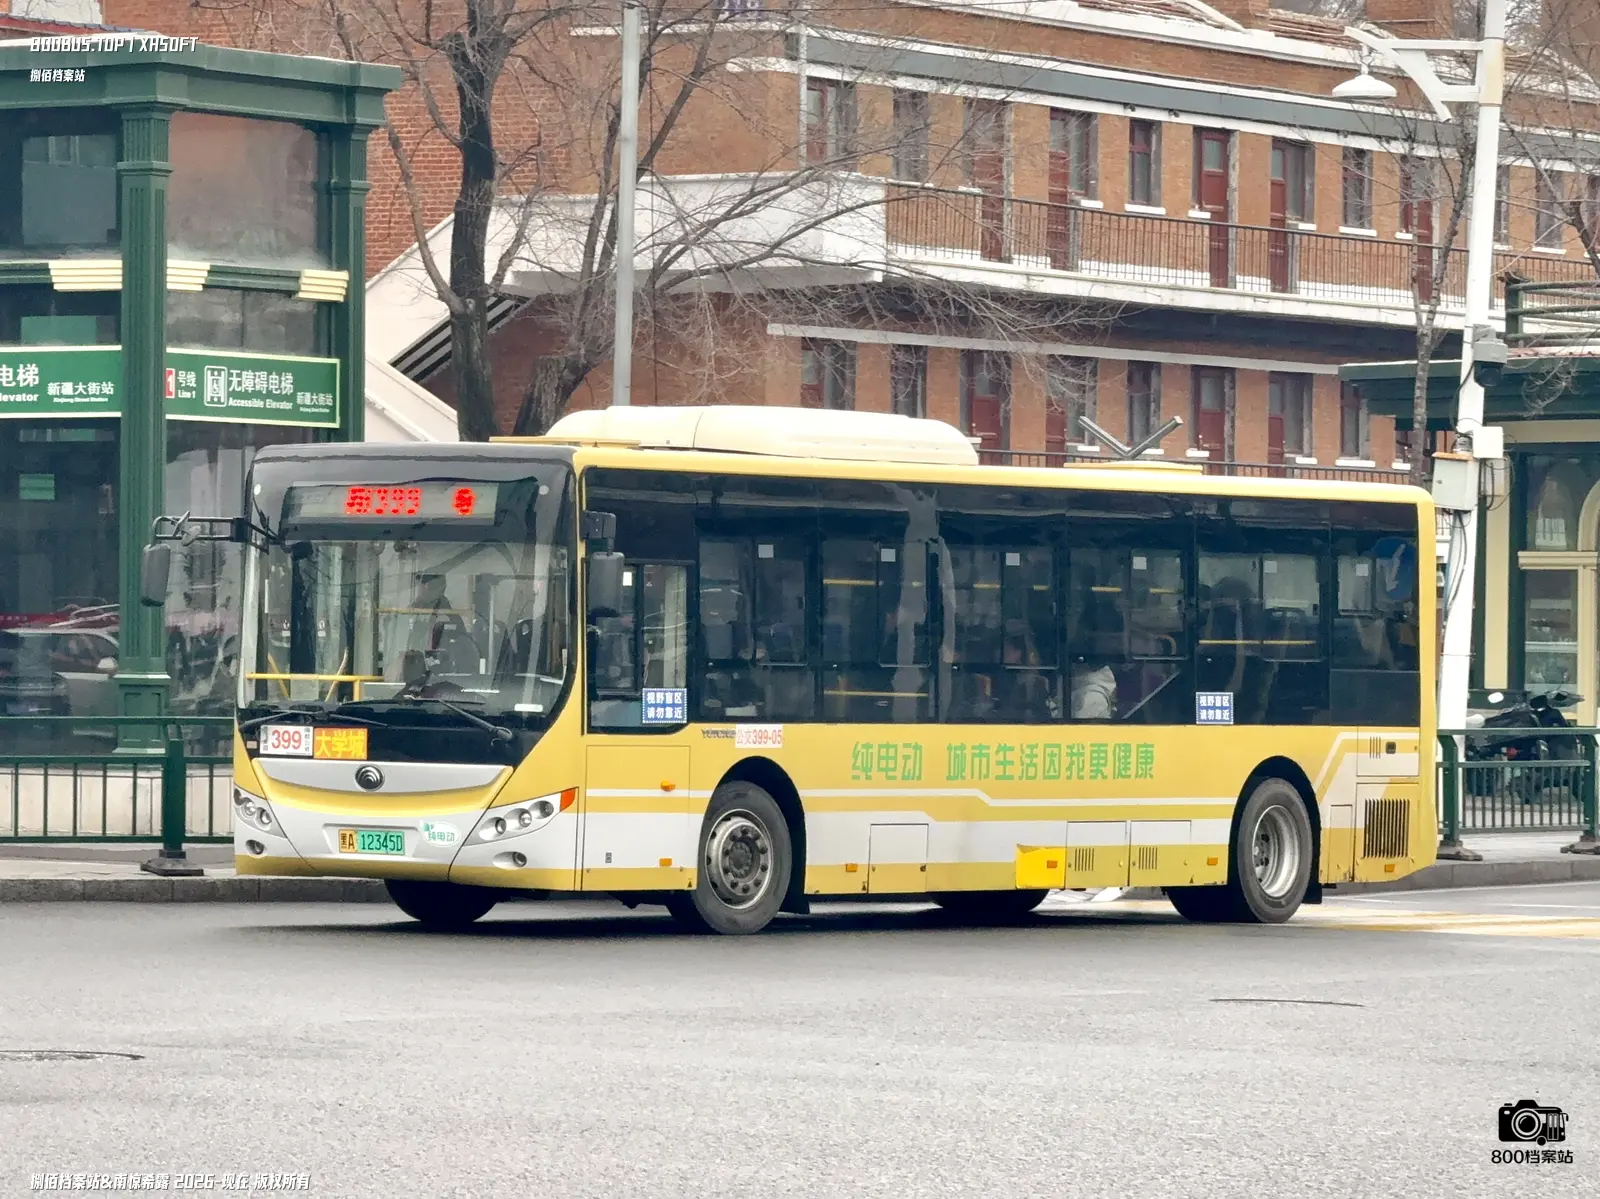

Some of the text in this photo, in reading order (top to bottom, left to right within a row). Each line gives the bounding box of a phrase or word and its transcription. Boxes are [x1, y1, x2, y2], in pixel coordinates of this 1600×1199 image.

[177, 371, 197, 388] 号线
[228, 369, 294, 396] 无障碍电梯
[47, 382, 115, 396] 新疆大街站
[228, 396, 264, 408] Accessible
[265, 398, 294, 410] Elevator
[646, 691, 683, 705] 视野盲区
[646, 707, 683, 719] 请勿靠近
[271, 729, 302, 750] 399
[314, 730, 366, 758] 大学城
[851, 741, 1156, 782] 纯电动 城市生活因我更健康
